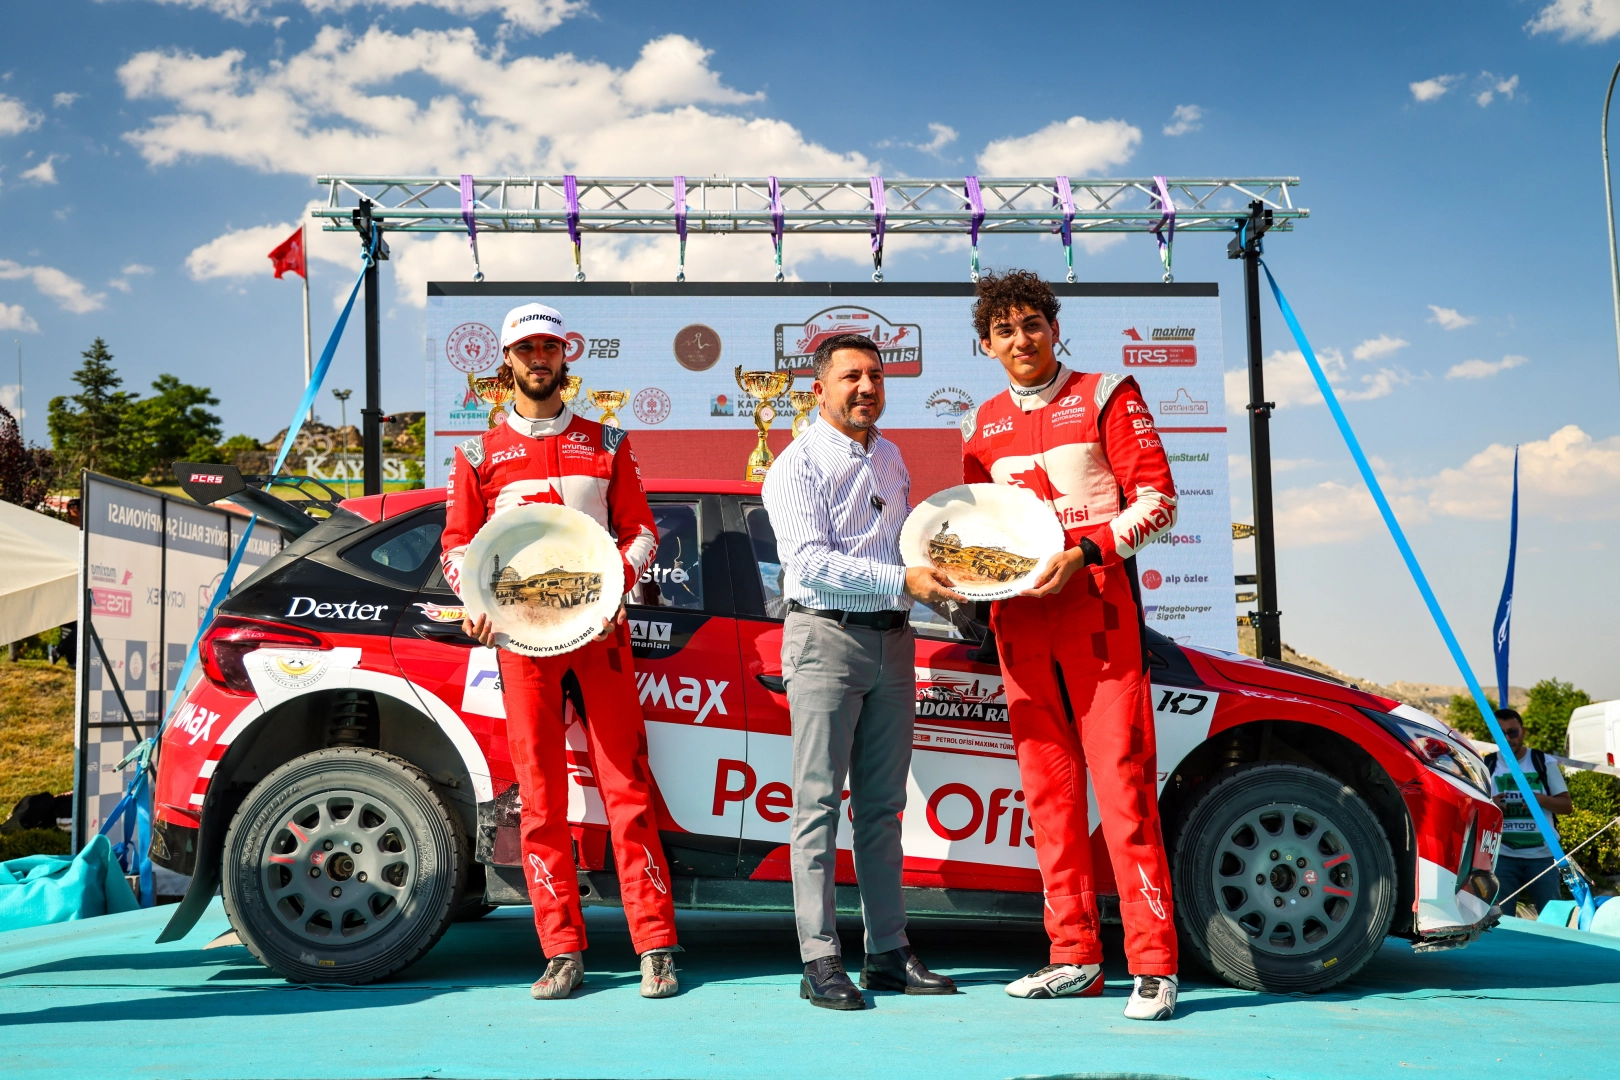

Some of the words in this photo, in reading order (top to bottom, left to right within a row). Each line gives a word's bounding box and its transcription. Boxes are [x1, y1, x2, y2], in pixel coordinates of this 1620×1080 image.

[1151, 325, 1196, 337] maxima
[589, 338, 620, 349] TOS
[588, 349, 619, 359] FED
[882, 347, 920, 364] ALLİSİ
[1125, 349, 1168, 363] TRS
[1051, 406, 1086, 419] HYUNDAI
[1051, 412, 1085, 424] MOTORSPORT
[982, 421, 1014, 439] KAZAZ
[561, 443, 596, 453] HYUNDAI
[491, 448, 527, 465] KAZAZ
[190, 473, 224, 484] PCRS
[1165, 574, 1181, 584] alp
[285, 596, 389, 622] Dexter
[1158, 605, 1212, 614] Magdeburger
[1156, 613, 1186, 621] Sigorta
[509, 638, 553, 652] KAPADOKYA
[580, 626, 596, 641] 2025
[633, 671, 730, 724] Max
[935, 736, 957, 744] PETROL
[958, 738, 974, 747] OFİSİ
[974, 741, 999, 749] MAXIMA
[999, 743, 1015, 751] TÜRK
[1055, 973, 1088, 993] ASTARS
